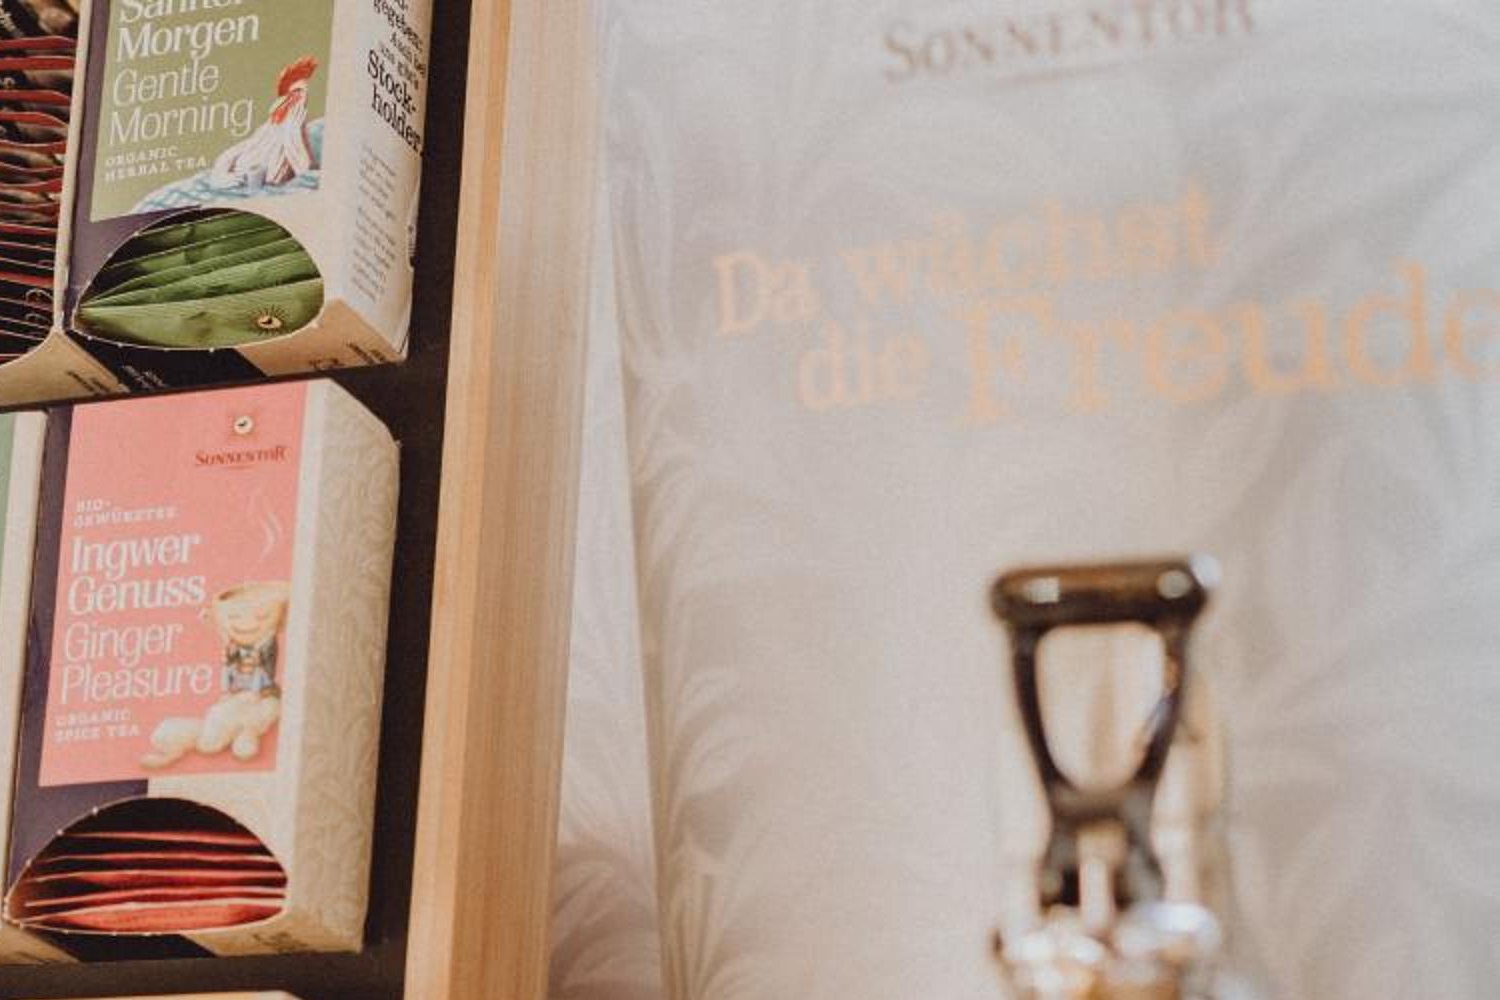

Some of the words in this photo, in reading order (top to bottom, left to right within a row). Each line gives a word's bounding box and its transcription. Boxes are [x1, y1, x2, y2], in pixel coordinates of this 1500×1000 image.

[116, 14, 259, 62] Morgen
[113, 57, 219, 107] Gentle
[110, 96, 254, 145] Morning
[105, 145, 178, 167] ORGANIC
[175, 155, 208, 171] TEA
[712, 248, 817, 340] Da
[70, 533, 202, 580] Ingwer
[67, 575, 206, 615] Genuss
[64, 621, 184, 666] Ginger
[60, 662, 213, 705] Pleasure
